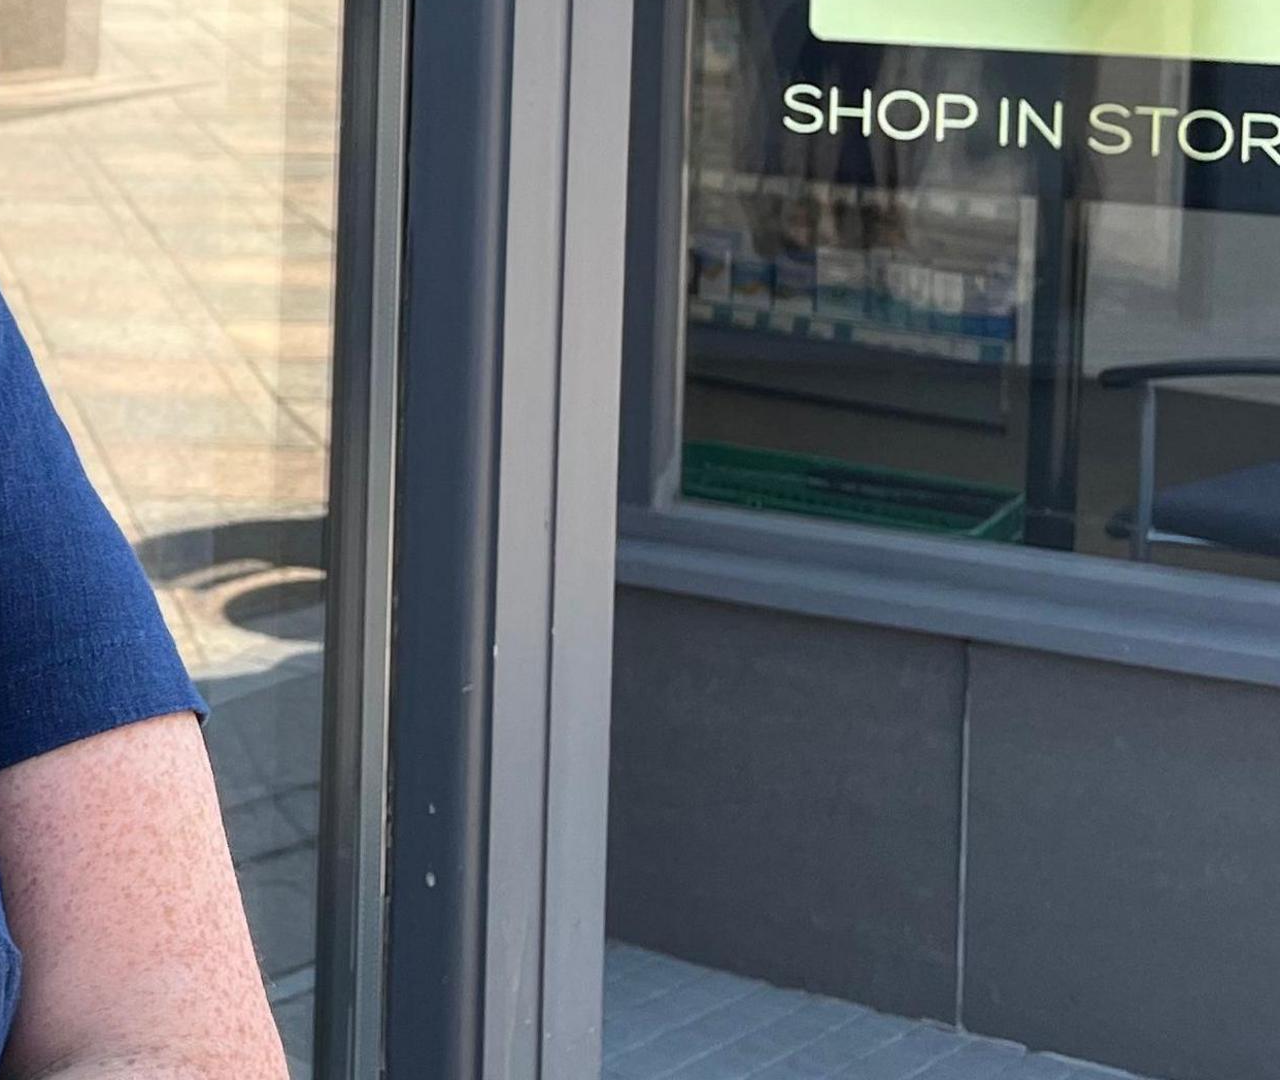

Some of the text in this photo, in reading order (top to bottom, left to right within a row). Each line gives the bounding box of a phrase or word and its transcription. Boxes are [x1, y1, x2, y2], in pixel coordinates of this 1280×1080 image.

[782, 82, 1280, 164] SHOP IN STOR
